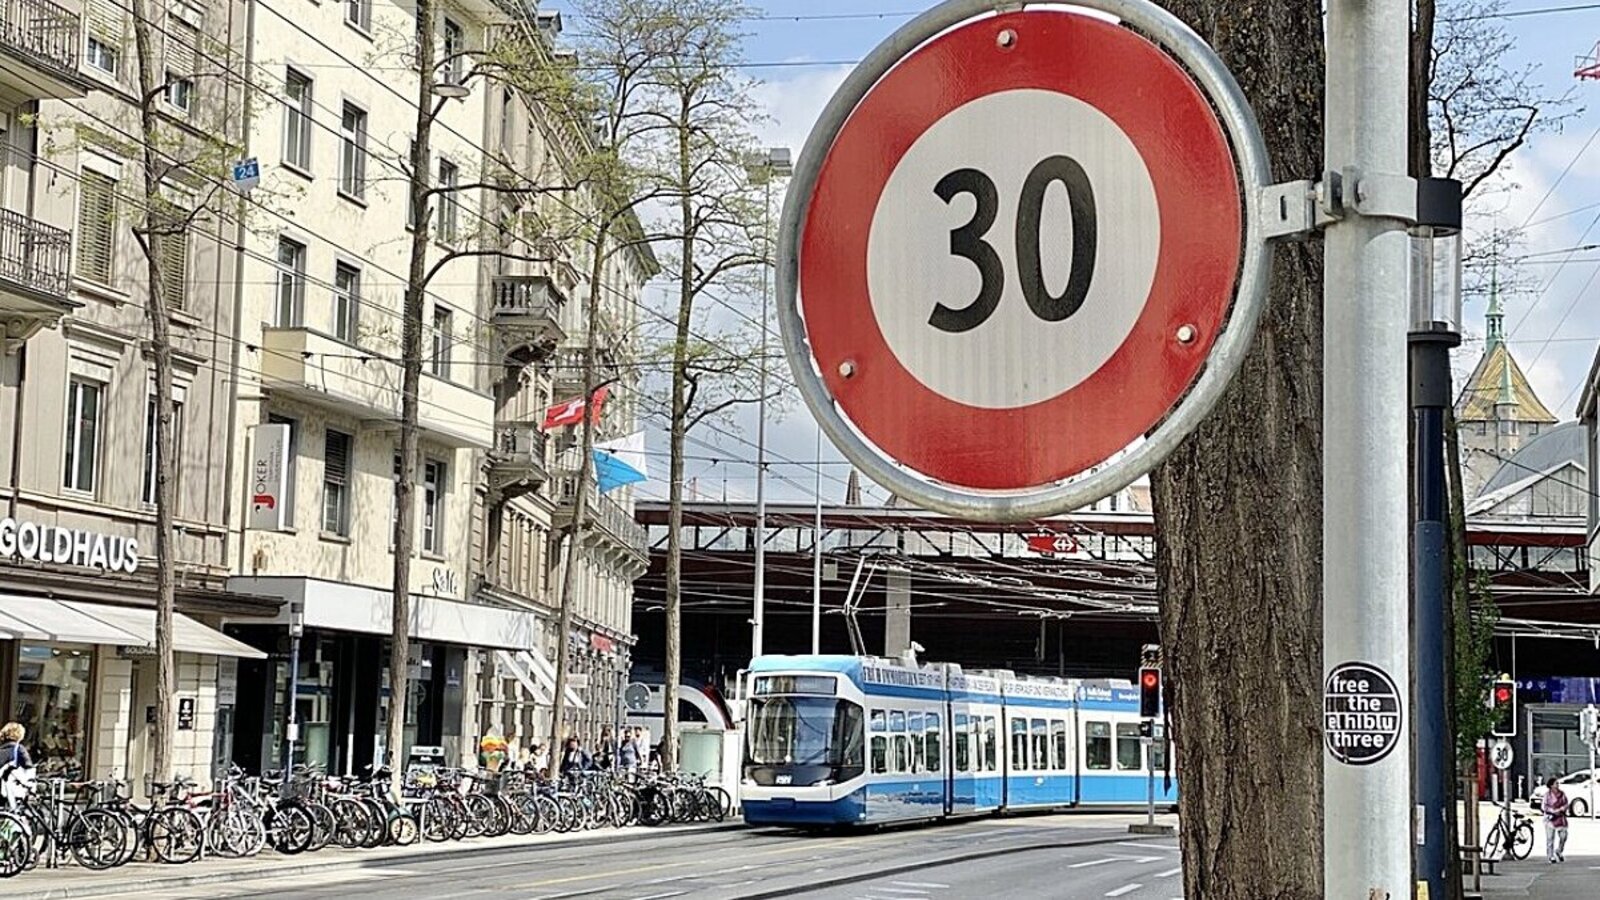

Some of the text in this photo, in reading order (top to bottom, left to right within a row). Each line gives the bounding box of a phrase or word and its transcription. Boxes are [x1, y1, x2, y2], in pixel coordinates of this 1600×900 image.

[928, 154, 1098, 333] 30
[254, 460, 275, 509] JOKER
[0, 517, 138, 573] GOLDHAUS
[1333, 675, 1370, 693] free
[1348, 695, 1381, 711] the
[1334, 731, 1385, 748] three
[1496, 747, 1508, 763] 30
